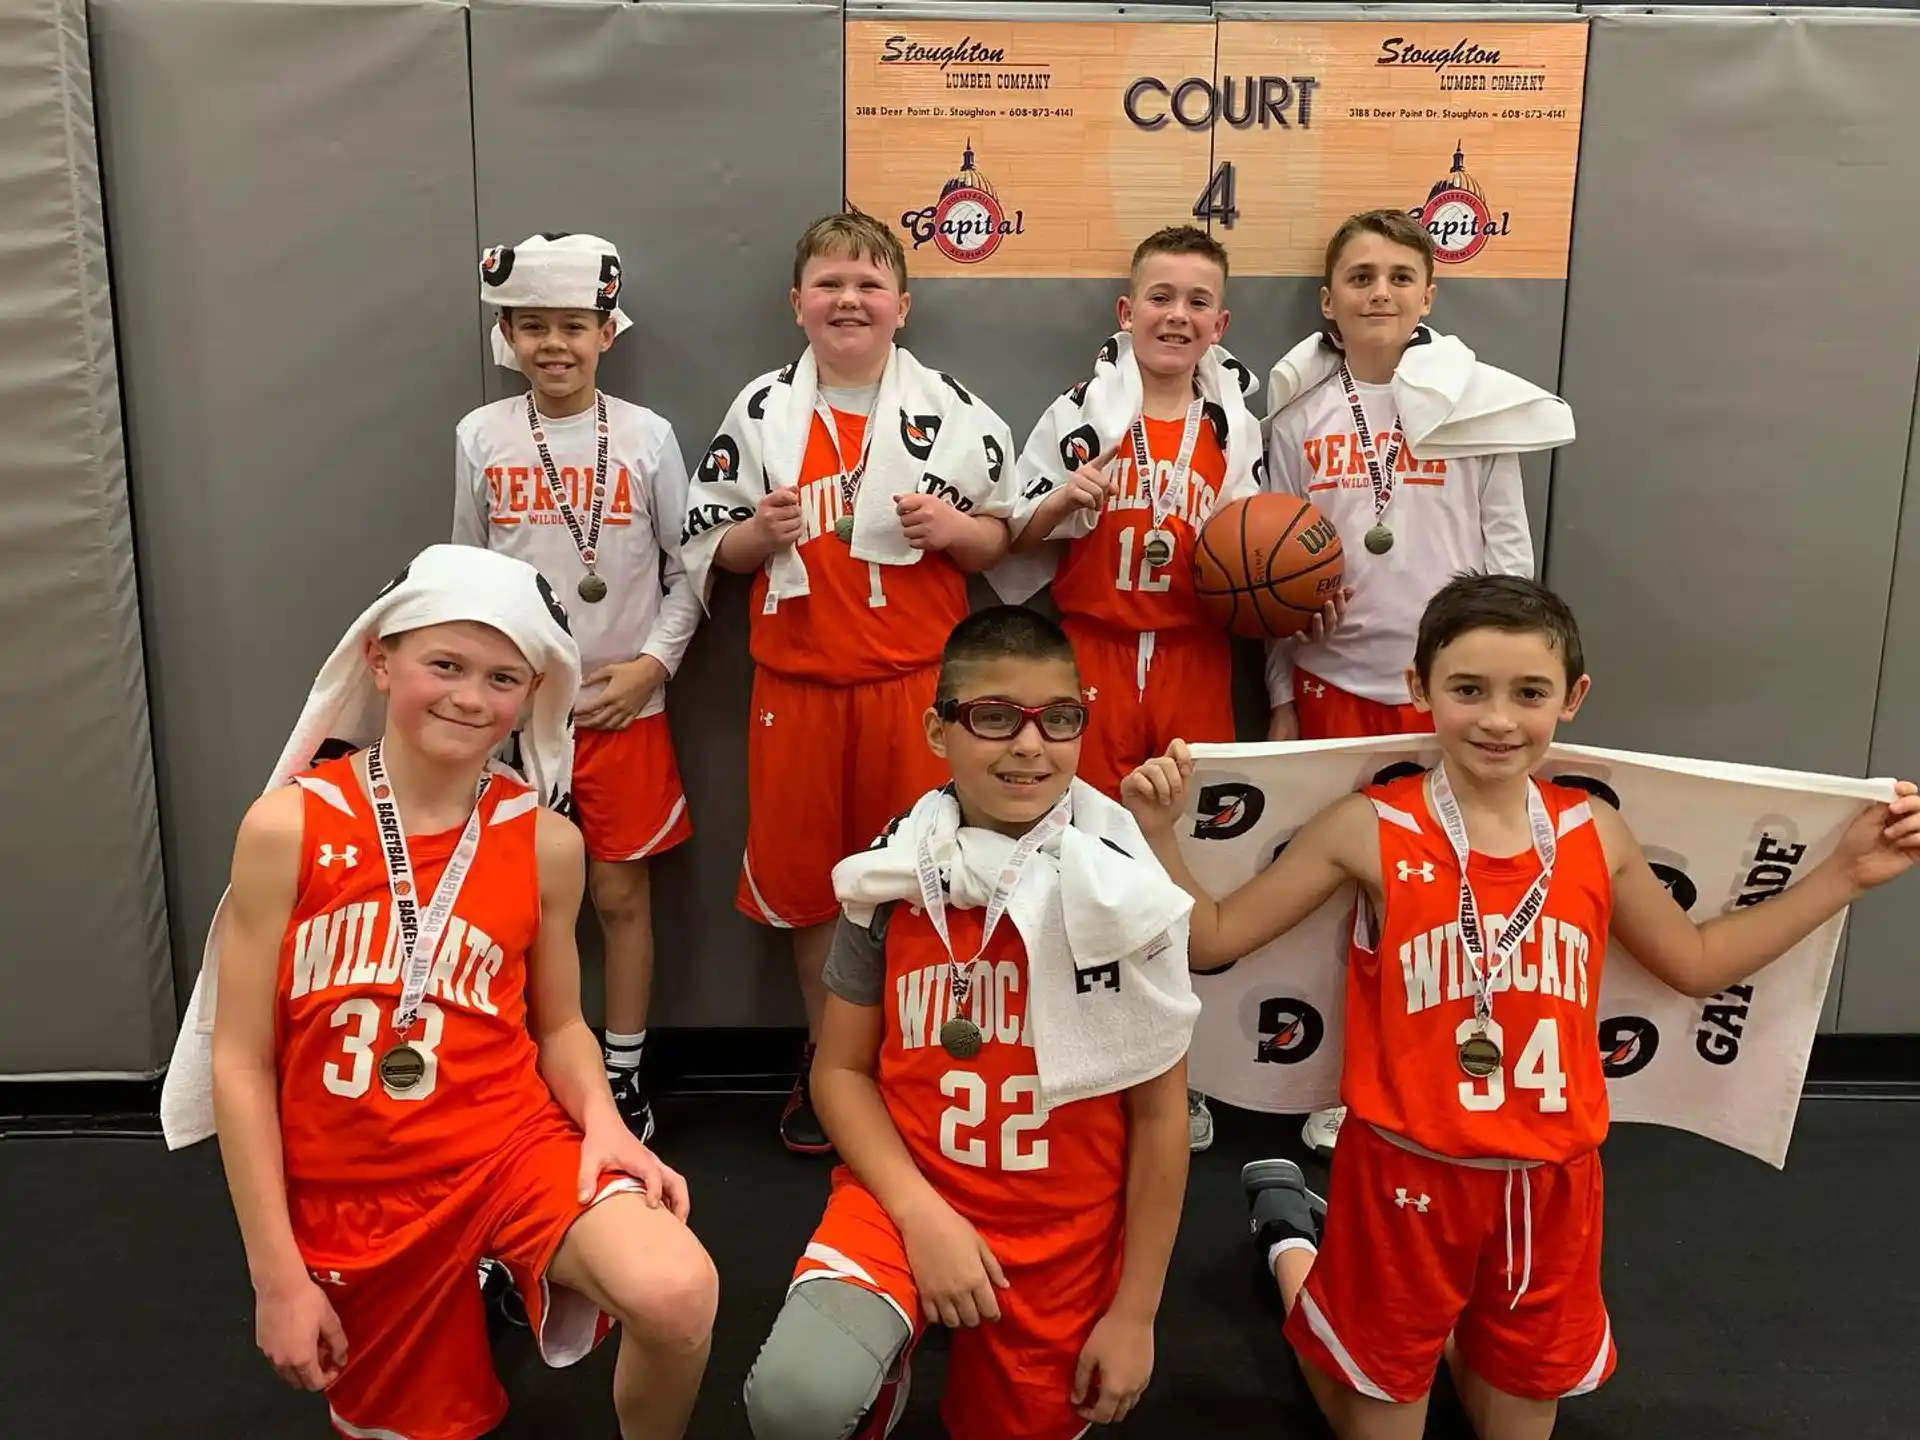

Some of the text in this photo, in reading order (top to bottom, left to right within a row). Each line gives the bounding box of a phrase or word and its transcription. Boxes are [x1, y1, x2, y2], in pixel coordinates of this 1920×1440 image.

[881, 36, 1004, 70] Stoughton
[1377, 37, 1501, 73] Stoughton
[945, 73, 1051, 90] LUMBER COMPANY
[1123, 75, 1319, 129] COURT
[1440, 75, 1546, 91] LUMBER COMPANY
[855, 106, 1074, 119] 3188 Deer Point Dr. Stoughton 608-873-4141
[1349, 108, 1566, 120] 3188 Deer Point Dr. Stoughton 608-873-4141
[1192, 160, 1239, 229] 4
[901, 206, 1025, 251] Capital
[1351, 404, 1372, 448] BASKETBALL
[537, 443, 563, 492] BASKETBALL
[596, 435, 609, 486] BASKETBALL
[560, 503, 588, 552] BASKETBALL
[586, 499, 604, 550] BASKETBALL
[1115, 526, 1176, 592] 12
[376, 803, 408, 876] BASKETBALL
[1460, 884, 1483, 954] BASKETBALL
[1497, 886, 1542, 952] BASKETBALL
[289, 901, 504, 1017] WILDATS
[1696, 831, 1807, 1066] GATADE
[322, 998, 446, 1100] 33
[1455, 1018, 1567, 1113] 34
[940, 1069, 1050, 1171] 22
